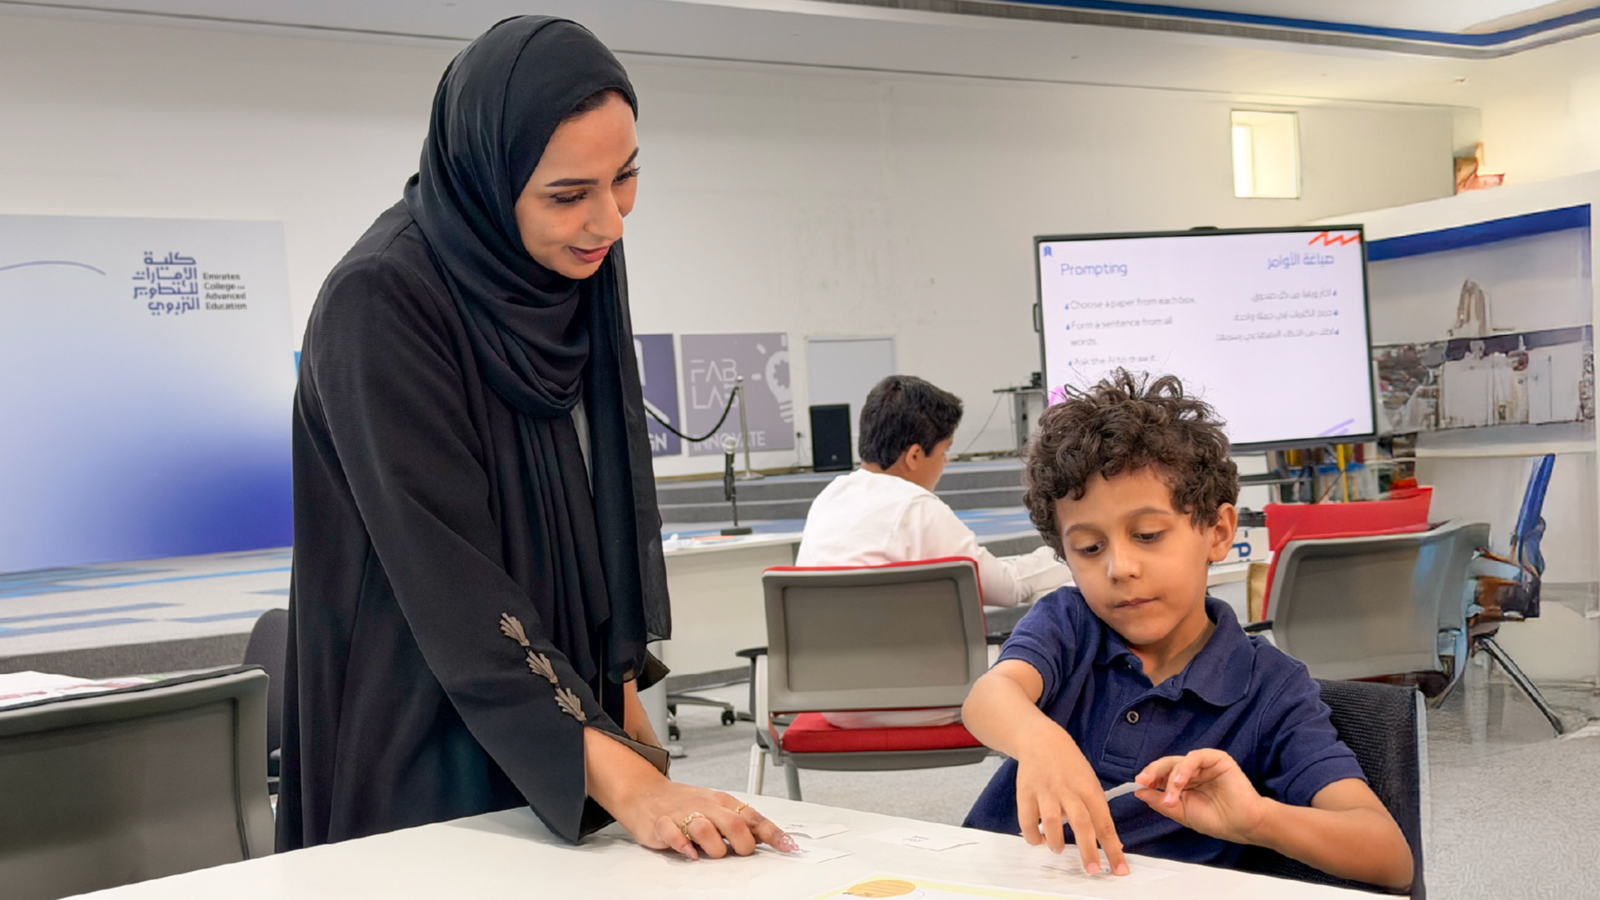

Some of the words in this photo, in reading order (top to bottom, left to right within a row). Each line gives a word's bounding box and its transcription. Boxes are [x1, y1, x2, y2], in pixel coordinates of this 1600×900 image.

[144, 251, 197, 265] كلية
[1303, 252, 1335, 268] صياغة
[132, 266, 197, 284] الإمارات
[203, 272, 241, 280] Emirates
[1061, 263, 1128, 277] Prompting
[204, 282, 236, 292] College
[205, 292, 246, 300] Advanced
[148, 296, 200, 316] التربوي
[205, 302, 247, 310] Education
[1070, 299, 1102, 310] Choose
[690, 358, 738, 382] FAB
[692, 383, 739, 409] LAB
